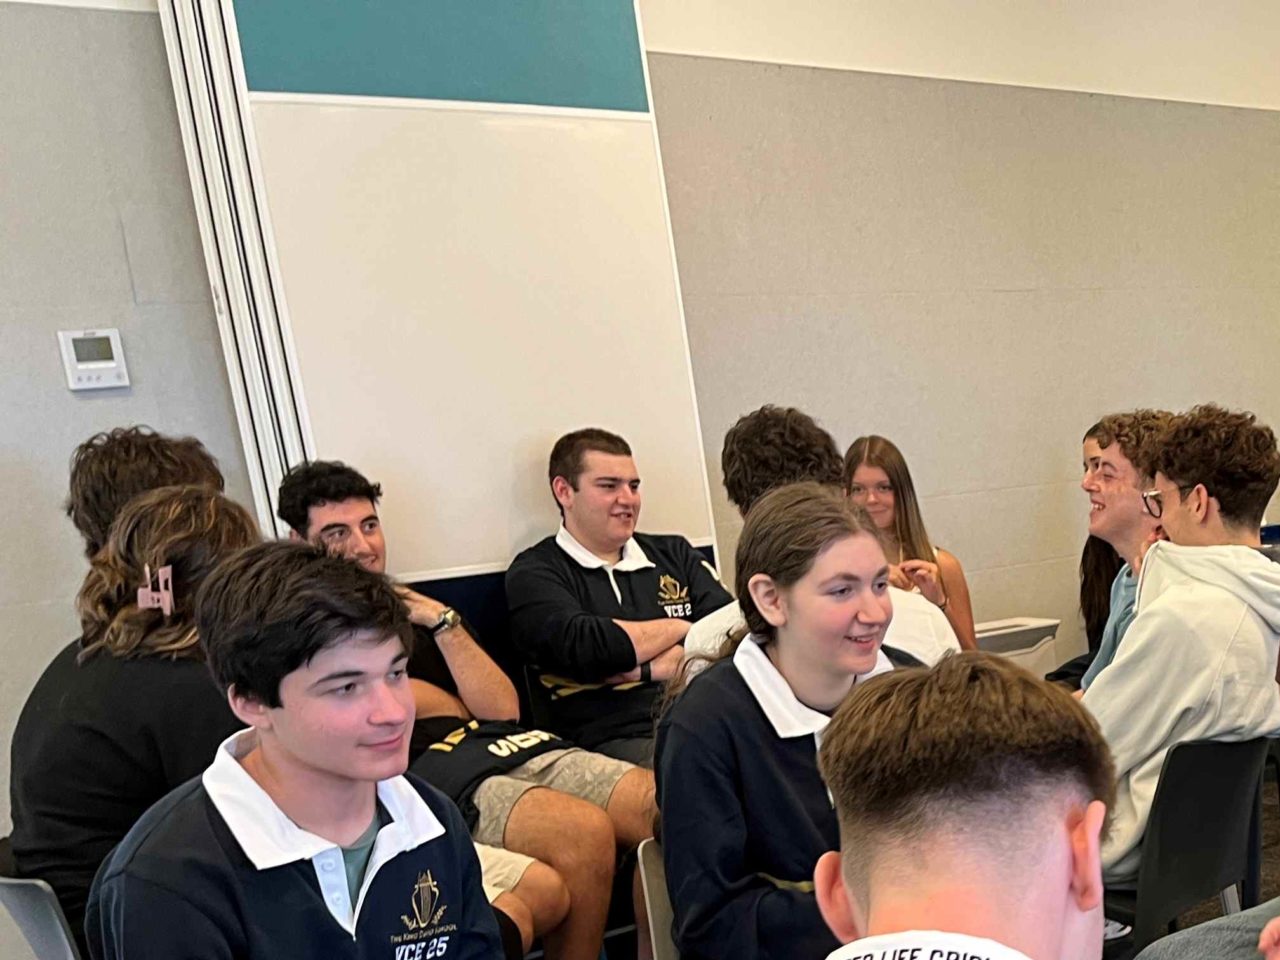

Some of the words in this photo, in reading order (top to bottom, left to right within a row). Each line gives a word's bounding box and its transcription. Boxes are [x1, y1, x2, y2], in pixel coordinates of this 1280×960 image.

[664, 604, 685, 618] VCE
[684, 602, 693, 616] 2
[426, 936, 450, 960] 25
